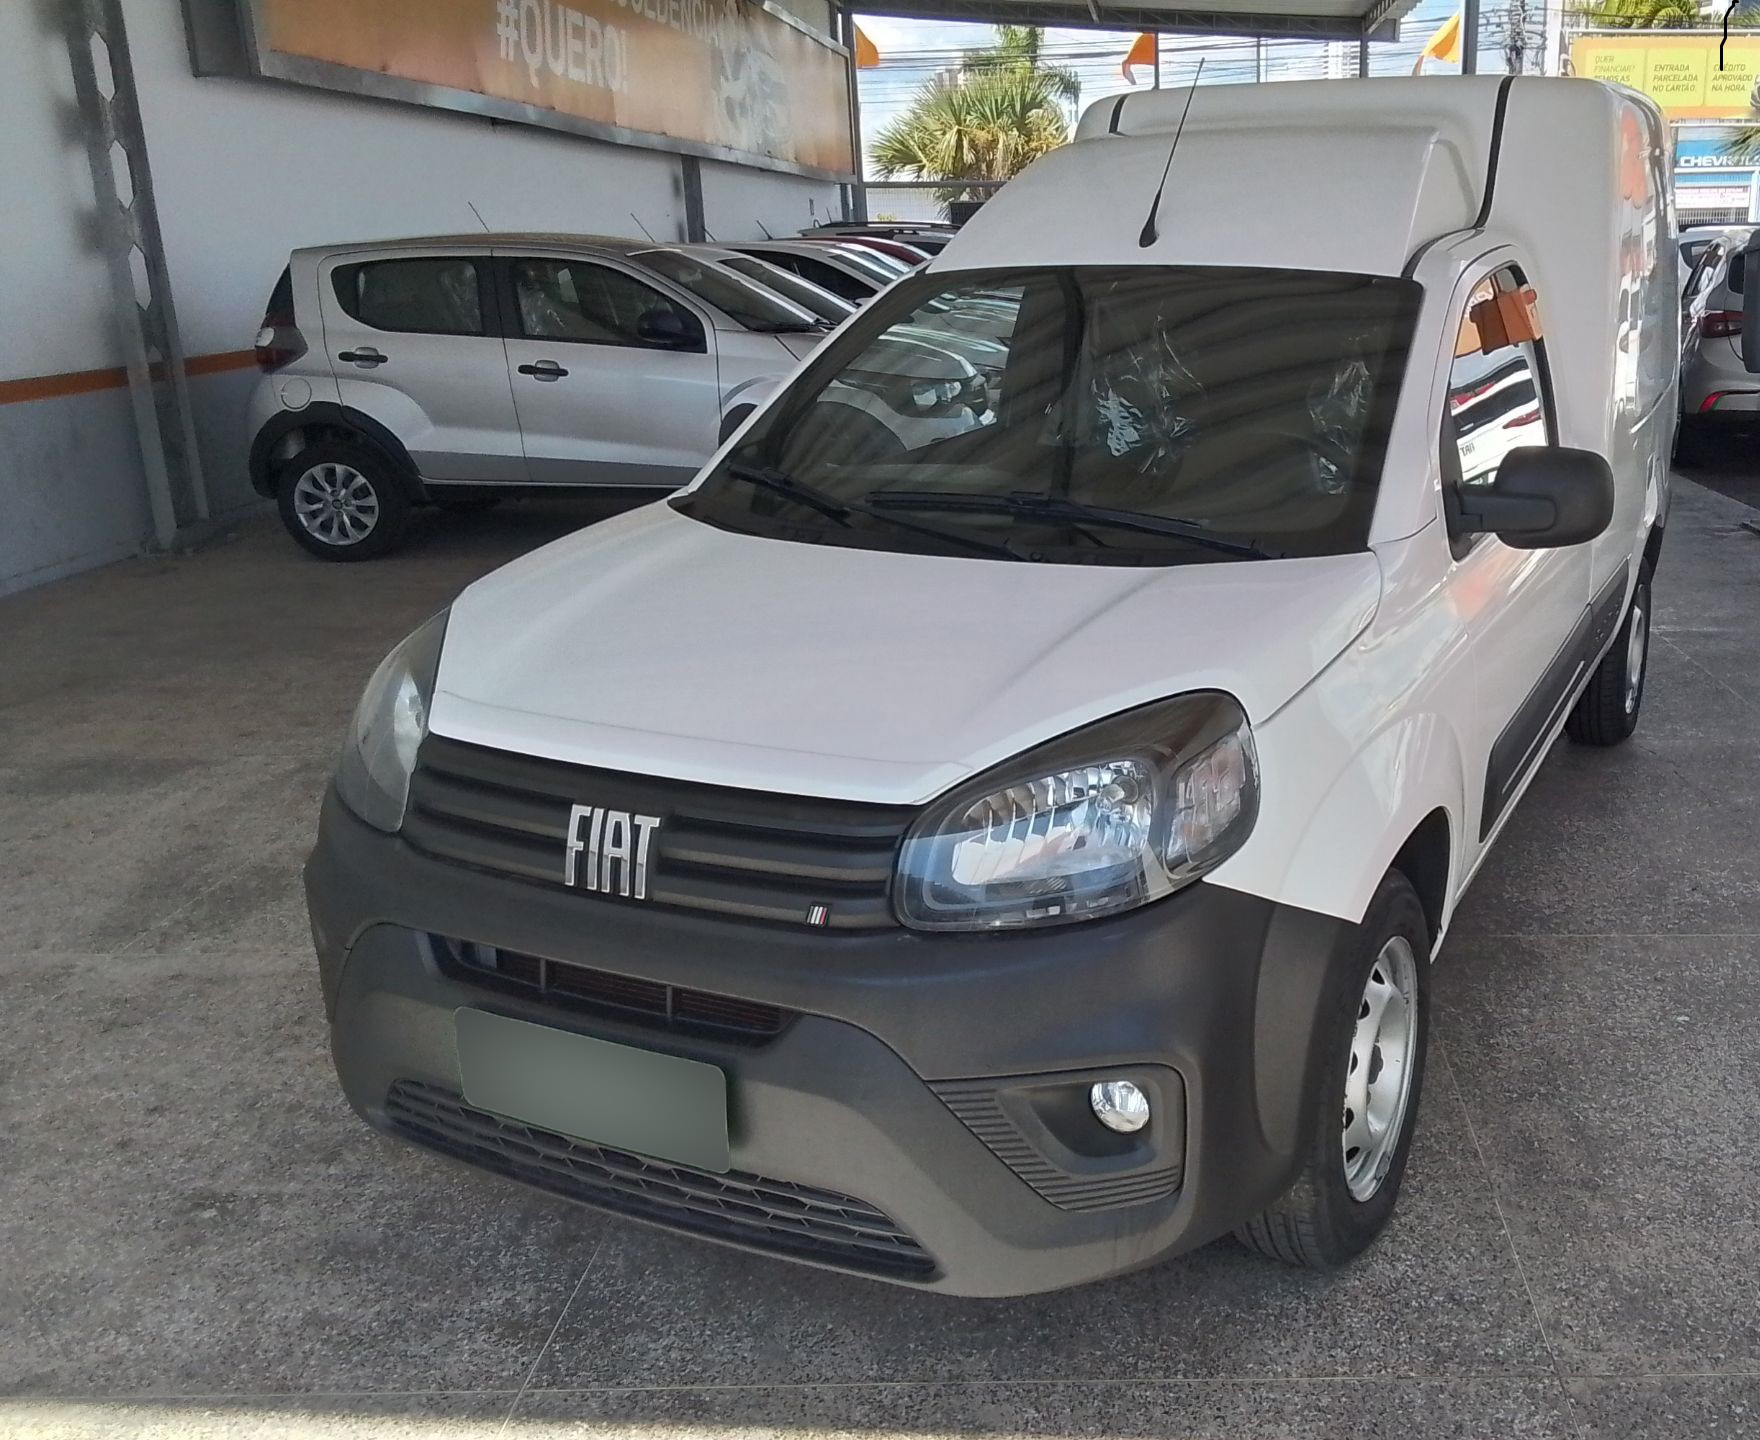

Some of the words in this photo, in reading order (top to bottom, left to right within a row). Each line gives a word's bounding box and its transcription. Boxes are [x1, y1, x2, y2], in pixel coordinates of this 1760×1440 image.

[496, 0, 627, 95] #QUERO!
[1653, 64, 1690, 72] ENTRADA
[1652, 74, 1698, 82] PARCELADA
[1711, 73, 1753, 82] APROVADO
[1652, 84, 1664, 92] NO
[1665, 82, 1696, 92] CARTÃO
[1711, 84, 1723, 92] NA
[1724, 84, 1746, 92] HORA
[564, 803, 662, 900] FIAT
